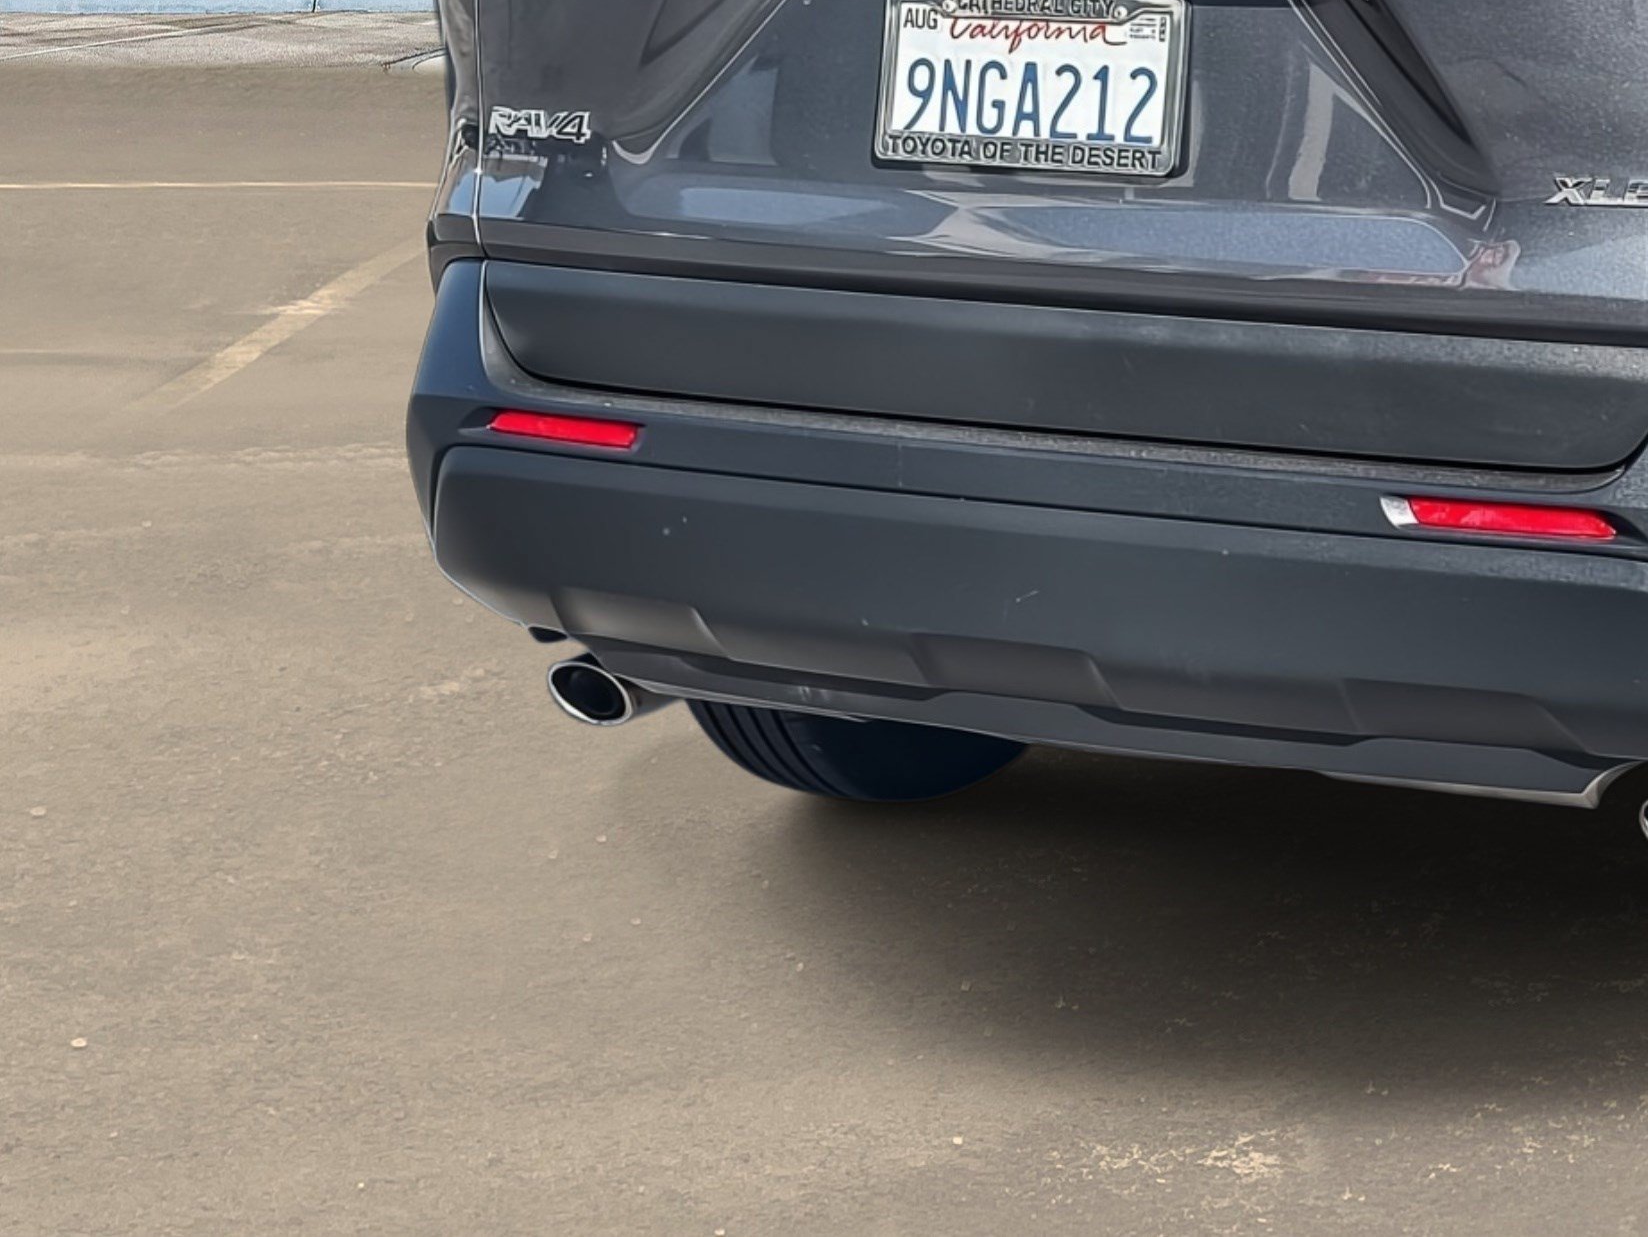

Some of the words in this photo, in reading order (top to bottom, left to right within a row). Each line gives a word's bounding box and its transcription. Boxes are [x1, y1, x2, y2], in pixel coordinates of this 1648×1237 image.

[902, 6, 939, 31] AUG
[949, 18, 1128, 54] California
[903, 57, 1158, 146] 9NGA212
[488, 106, 591, 144] RAV4
[887, 133, 971, 159] TOYOTA
[982, 141, 1014, 162] OF
[1021, 143, 1064, 165] THE
[1070, 146, 1162, 171] DESERT
